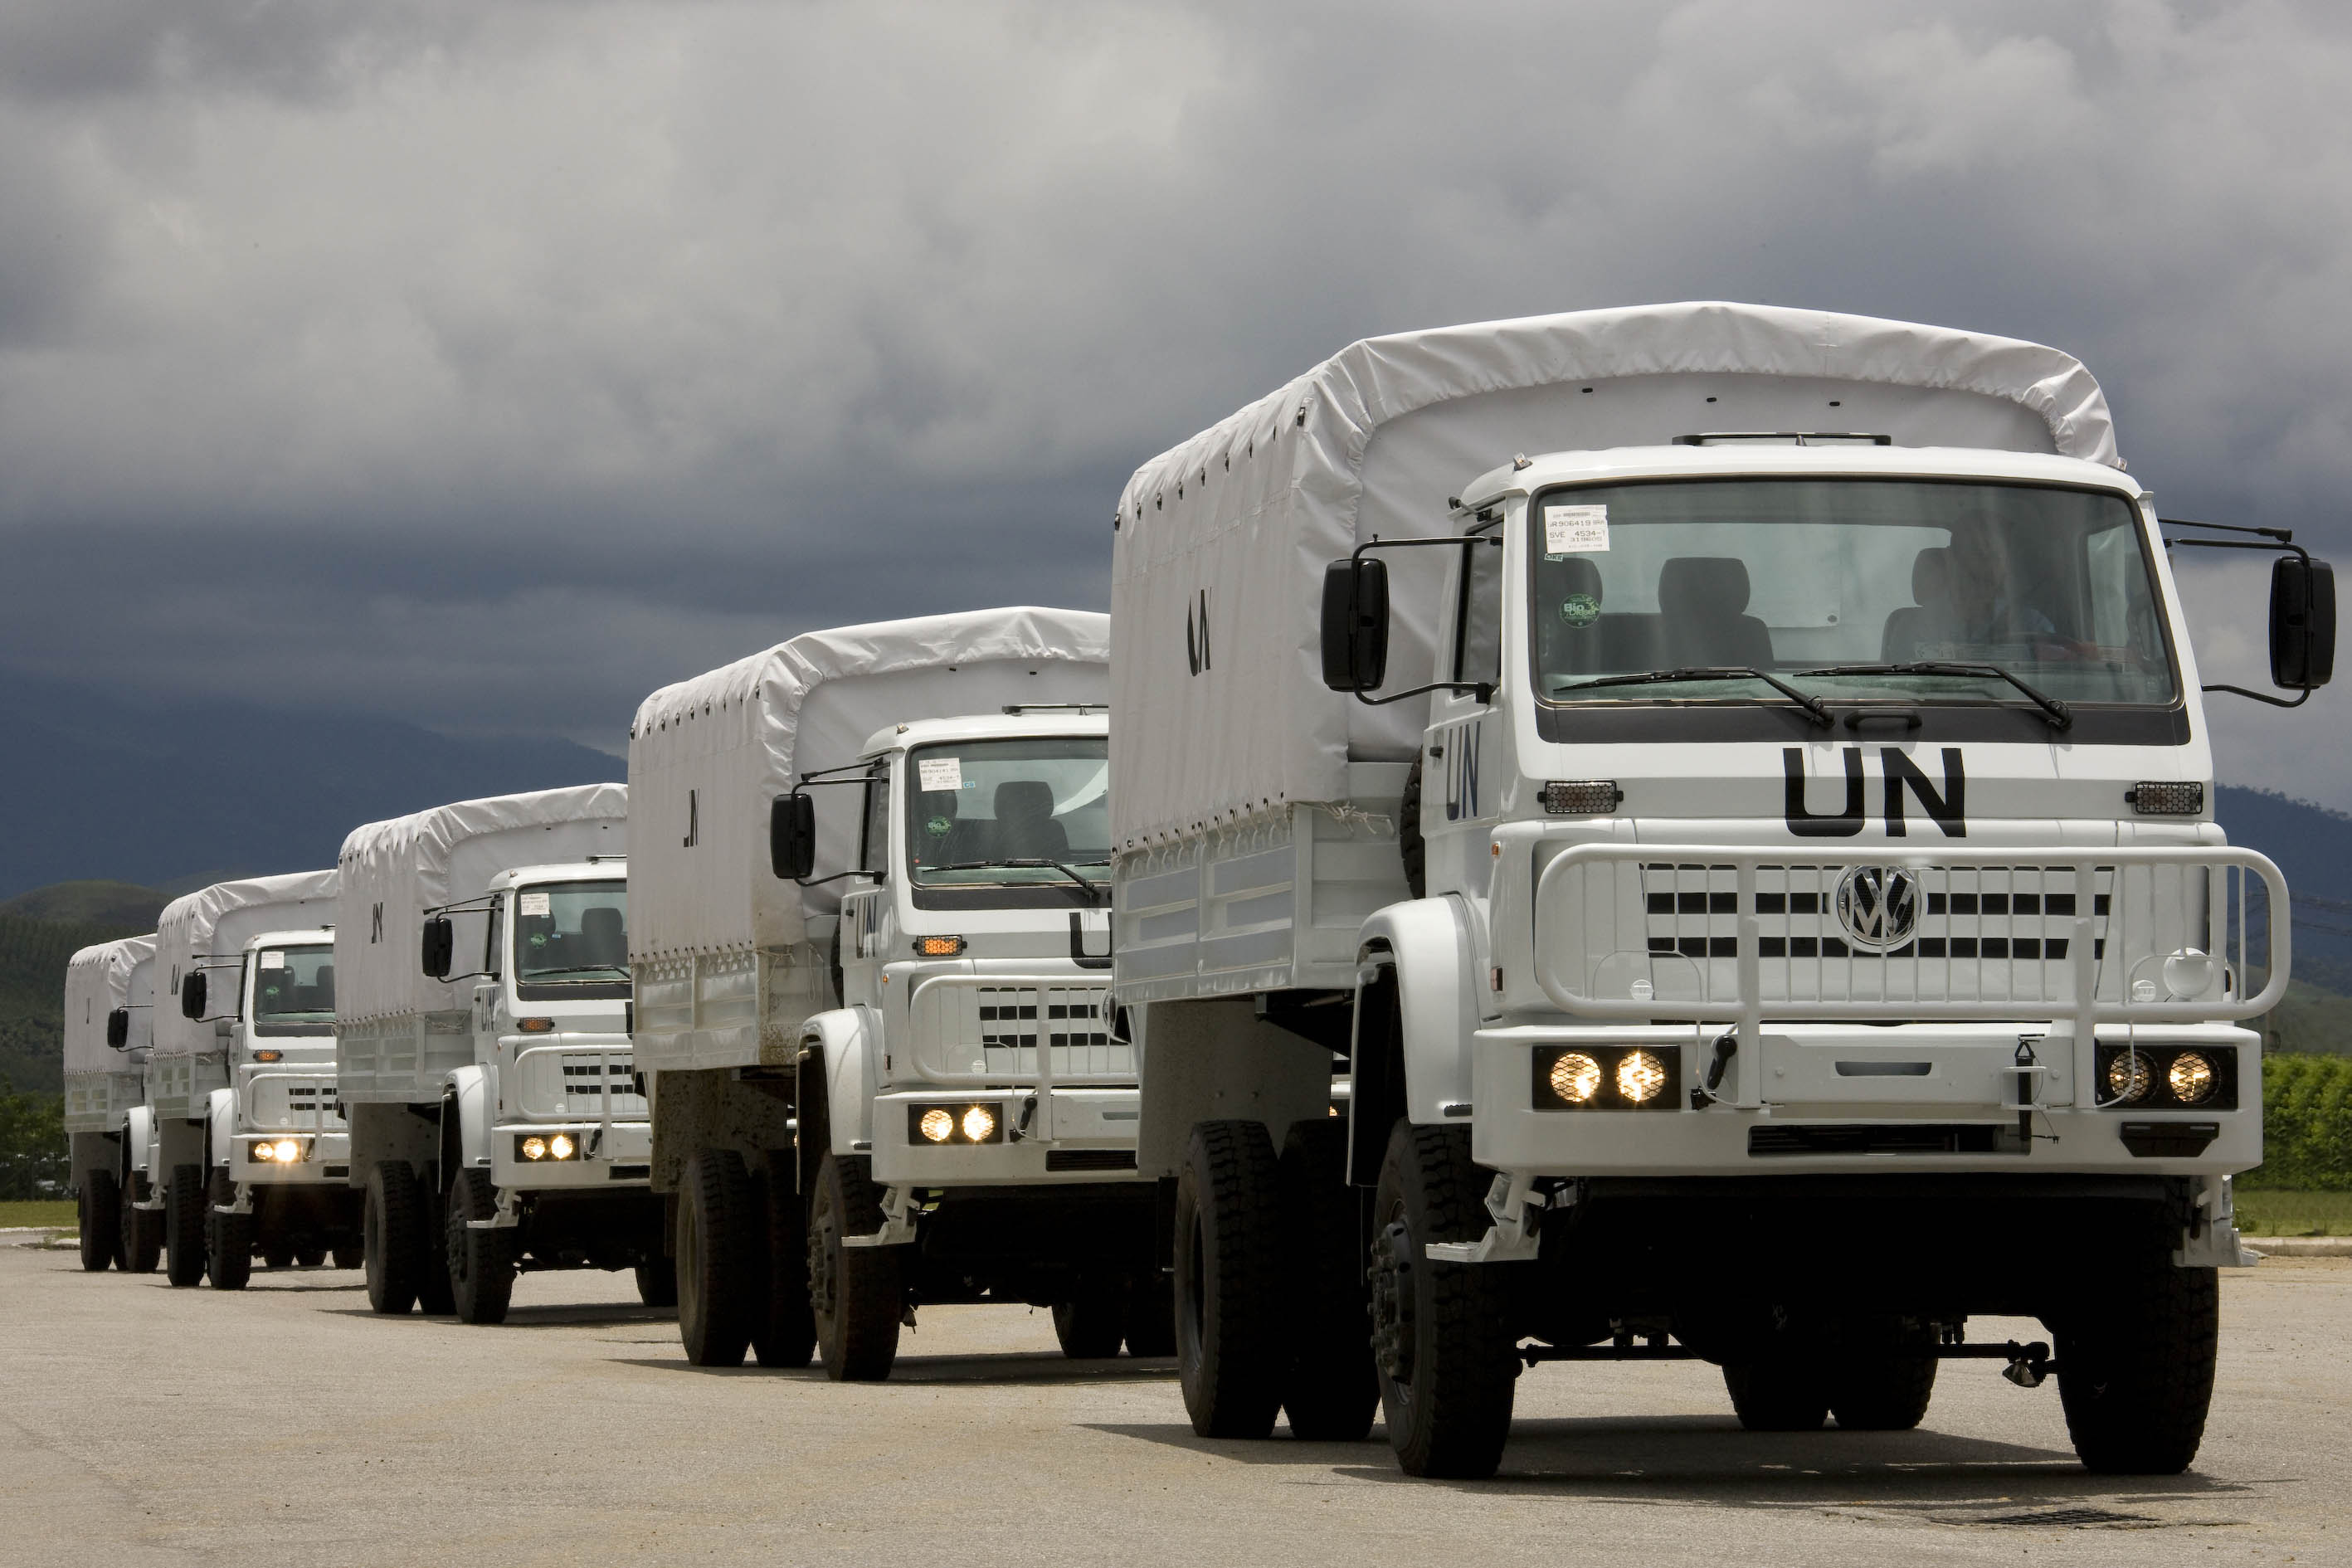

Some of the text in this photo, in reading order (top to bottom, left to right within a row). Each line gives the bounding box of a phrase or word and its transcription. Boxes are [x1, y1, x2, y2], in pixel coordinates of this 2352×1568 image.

[1446, 721, 1481, 821] UN
[1783, 747, 1967, 837] UN
[856, 896, 877, 959] UN
